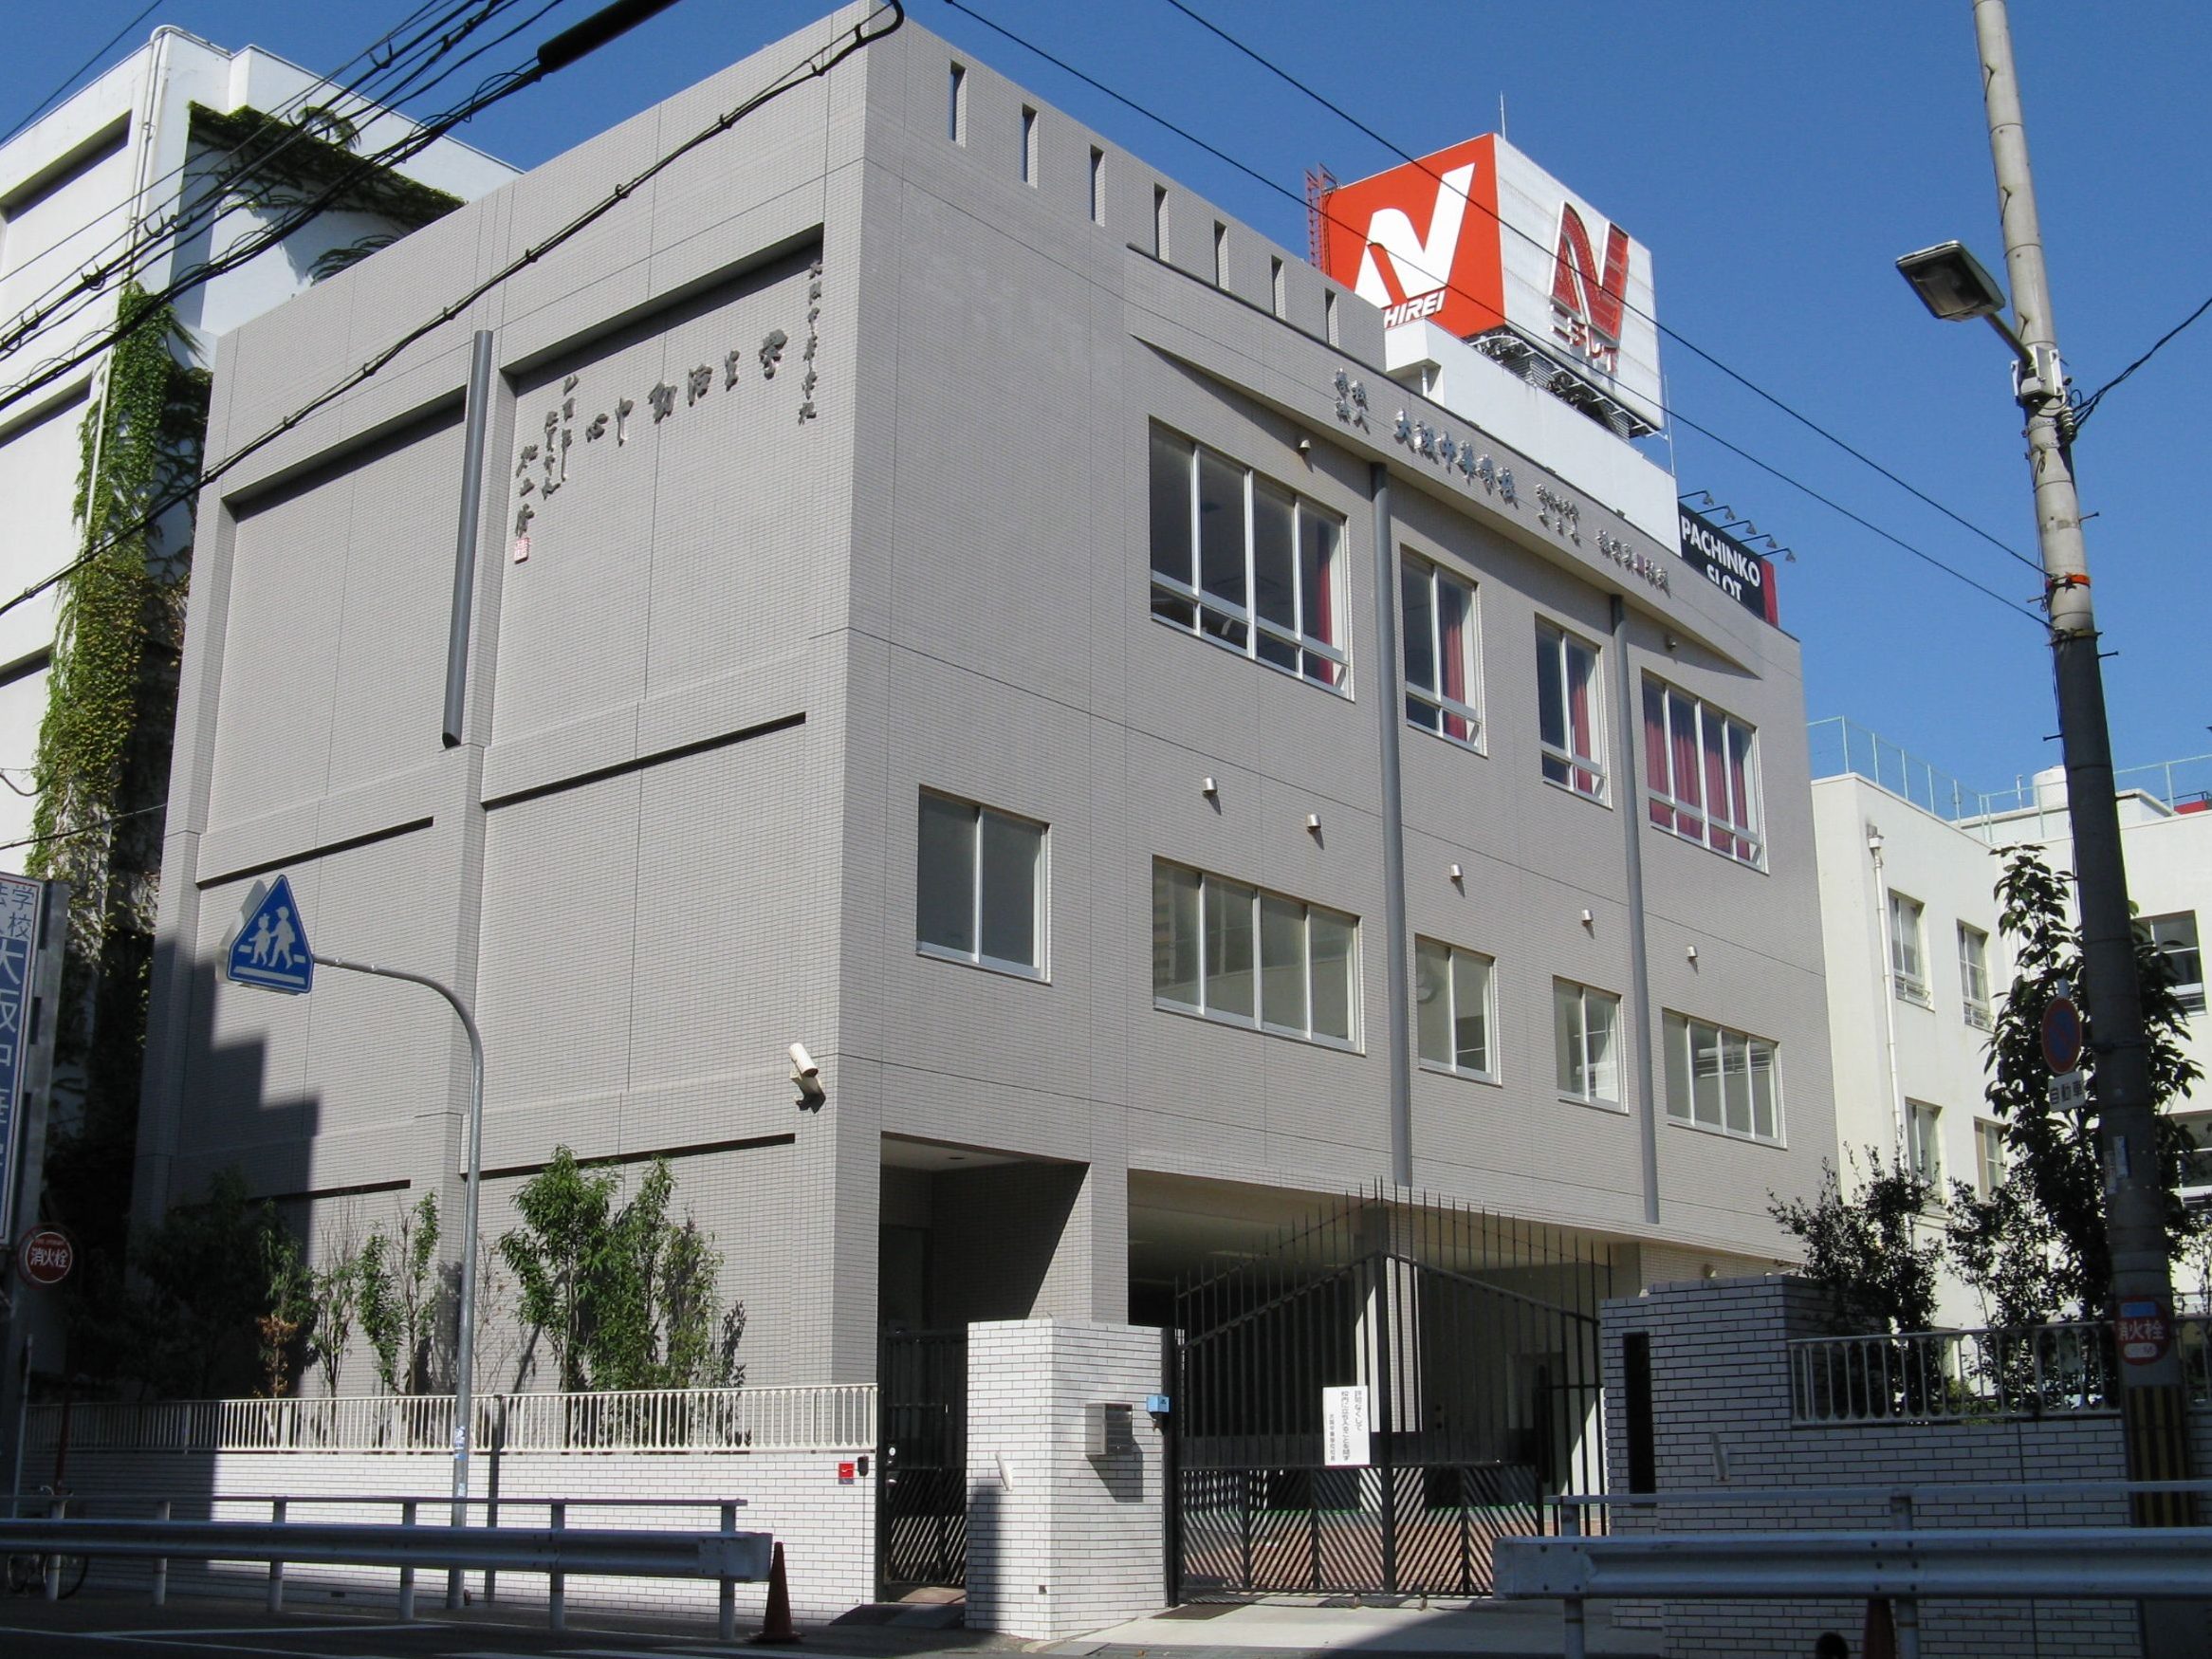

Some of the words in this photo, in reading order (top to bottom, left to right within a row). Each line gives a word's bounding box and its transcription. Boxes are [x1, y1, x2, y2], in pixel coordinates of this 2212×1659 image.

[1681, 515, 1760, 587] PACHINKO
[2049, 1080, 2082, 1104] 自動車
[30, 1247, 67, 1268] 消火栓
[2117, 1319, 2165, 1341] 消火栓
